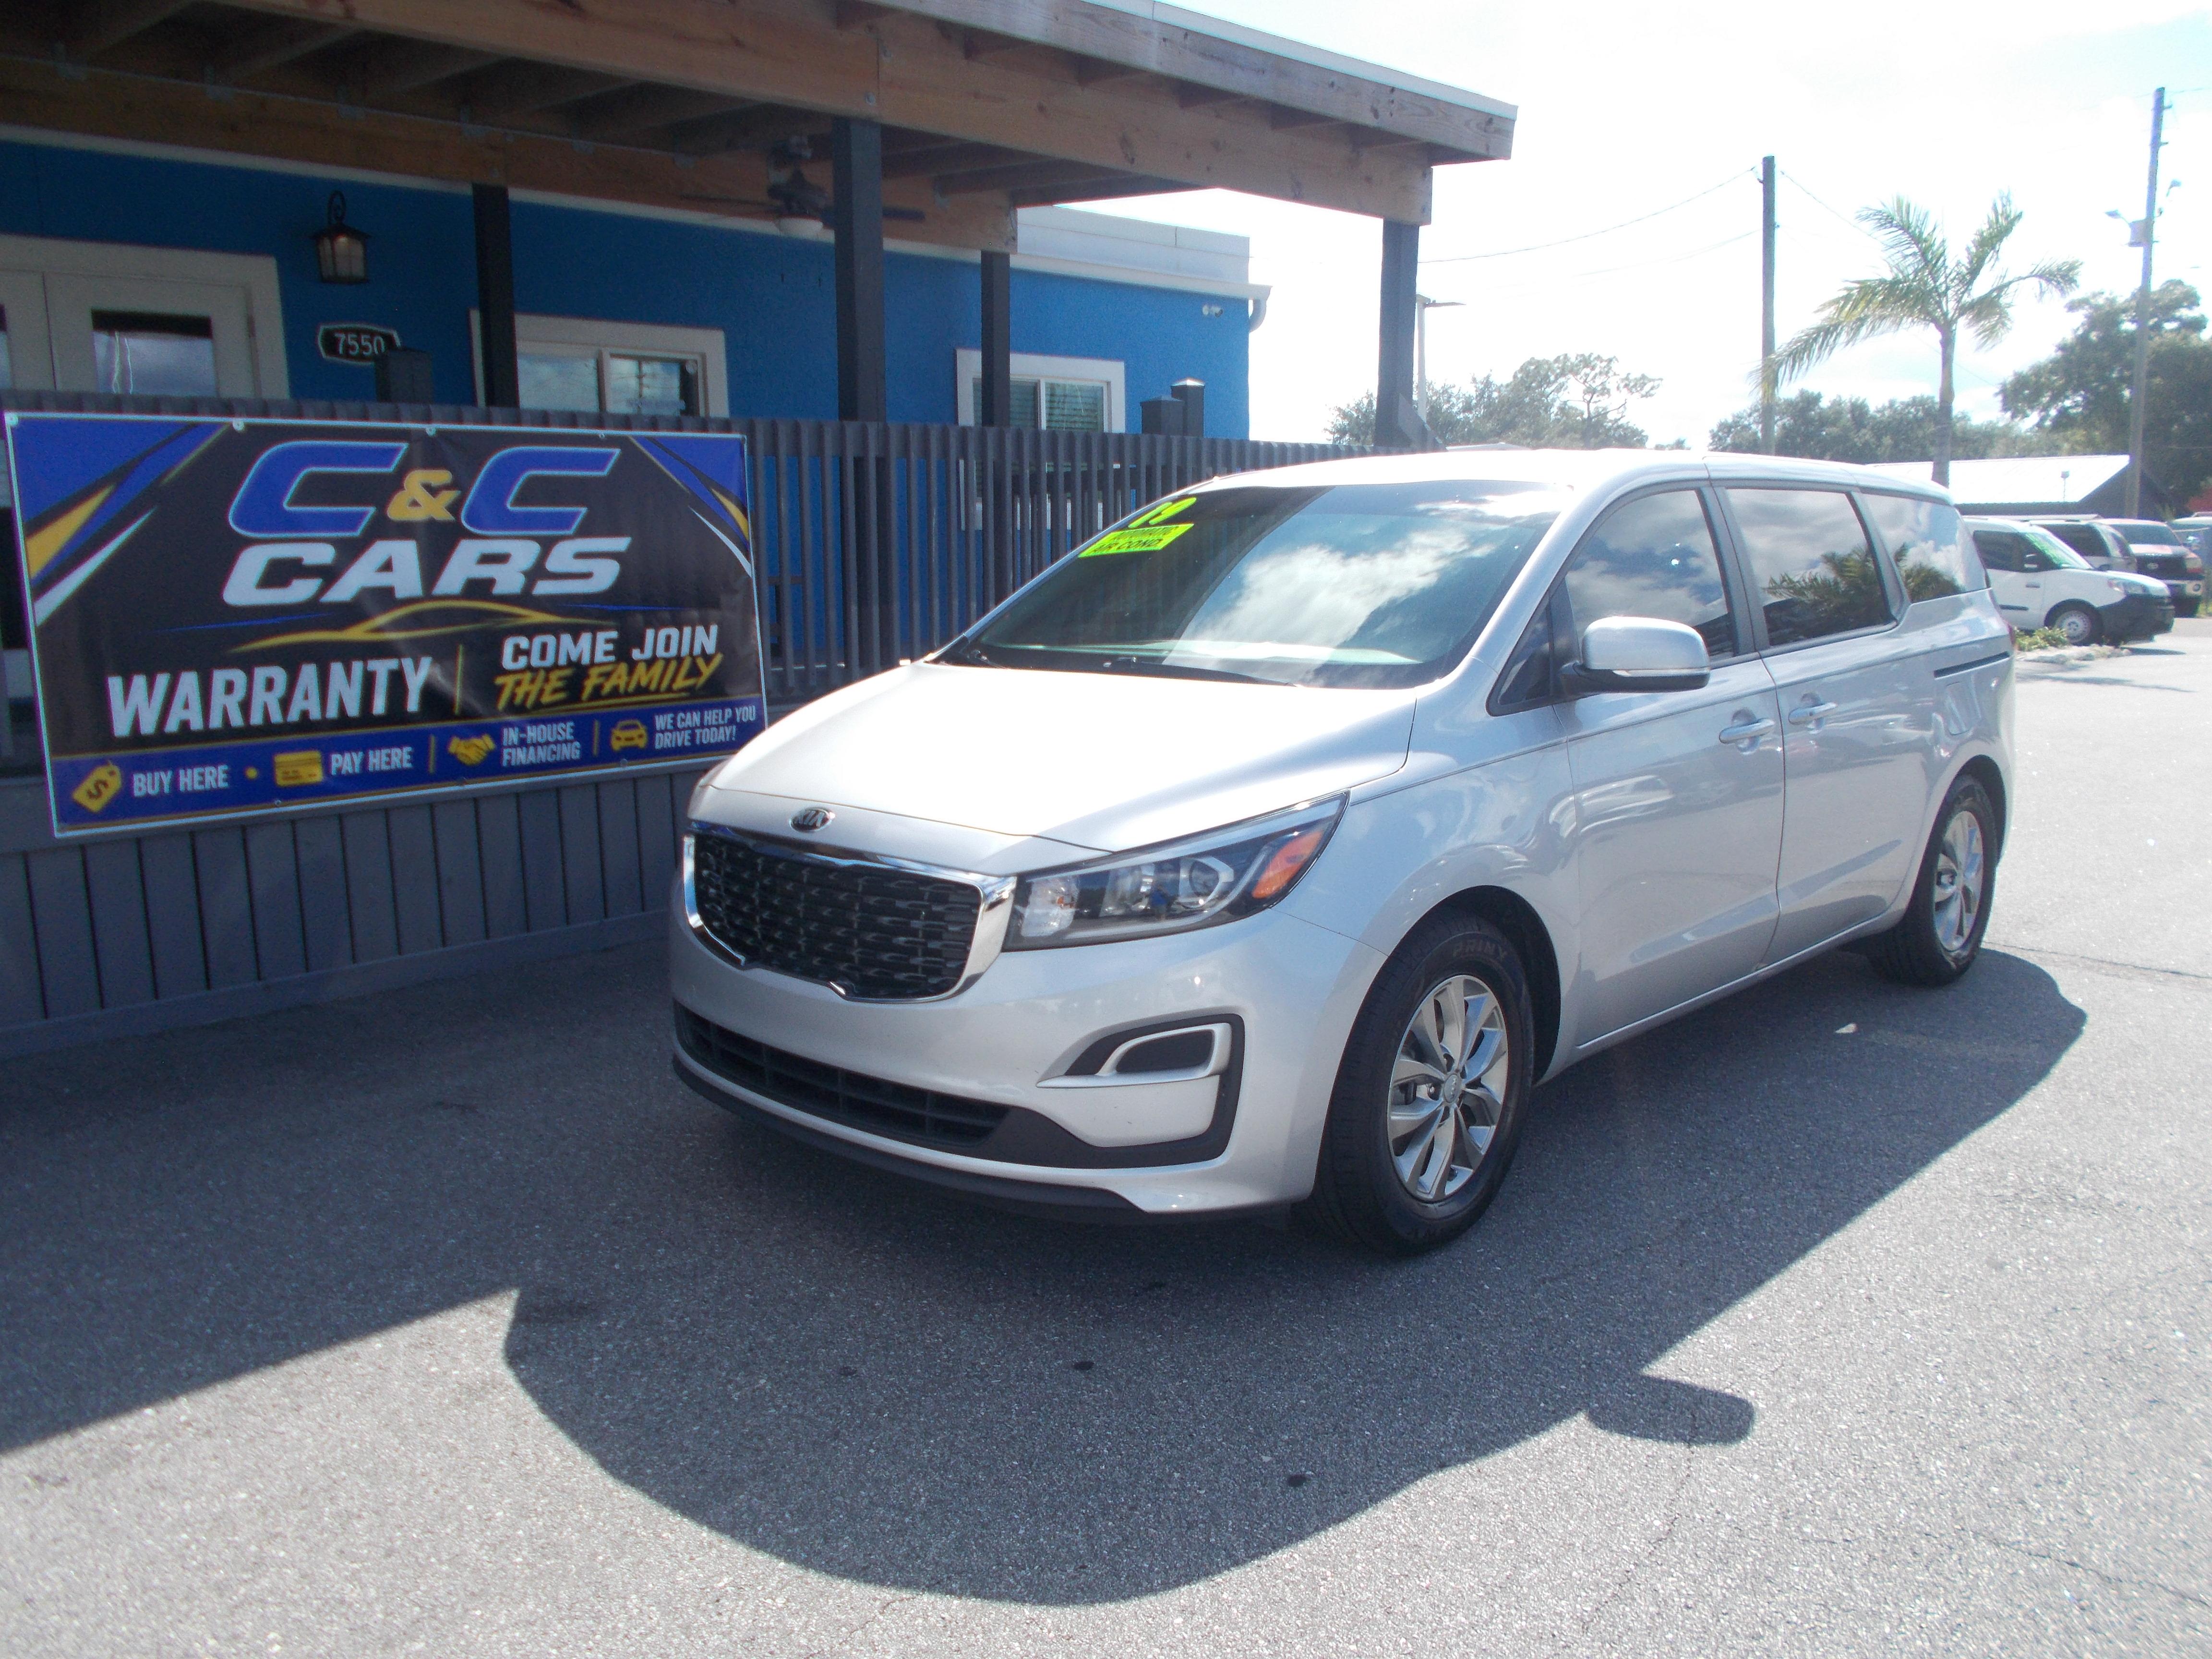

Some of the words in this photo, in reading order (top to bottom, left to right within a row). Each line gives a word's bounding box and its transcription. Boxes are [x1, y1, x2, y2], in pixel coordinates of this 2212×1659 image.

[335, 333, 385, 356] 7550
[222, 537, 632, 607] CARS
[502, 630, 618, 670] COME
[632, 624, 718, 660] JOIN
[494, 668, 575, 711] THE
[581, 652, 723, 700] FAMILY
[107, 657, 432, 737] WARRANTY
[655, 713, 675, 731] WE
[677, 712, 701, 728] CAN
[703, 709, 732, 726] HELP
[735, 706, 757, 722] YOU
[502, 721, 575, 746] IN-HOUSE
[654, 730, 691, 749] DRIVE
[695, 726, 736, 746] TODAY!
[331, 751, 364, 775] PAY
[368, 746, 413, 771] HERE
[502, 741, 580, 767] FINANCING
[133, 771, 173, 797] BUY
[180, 765, 229, 792] HERE
